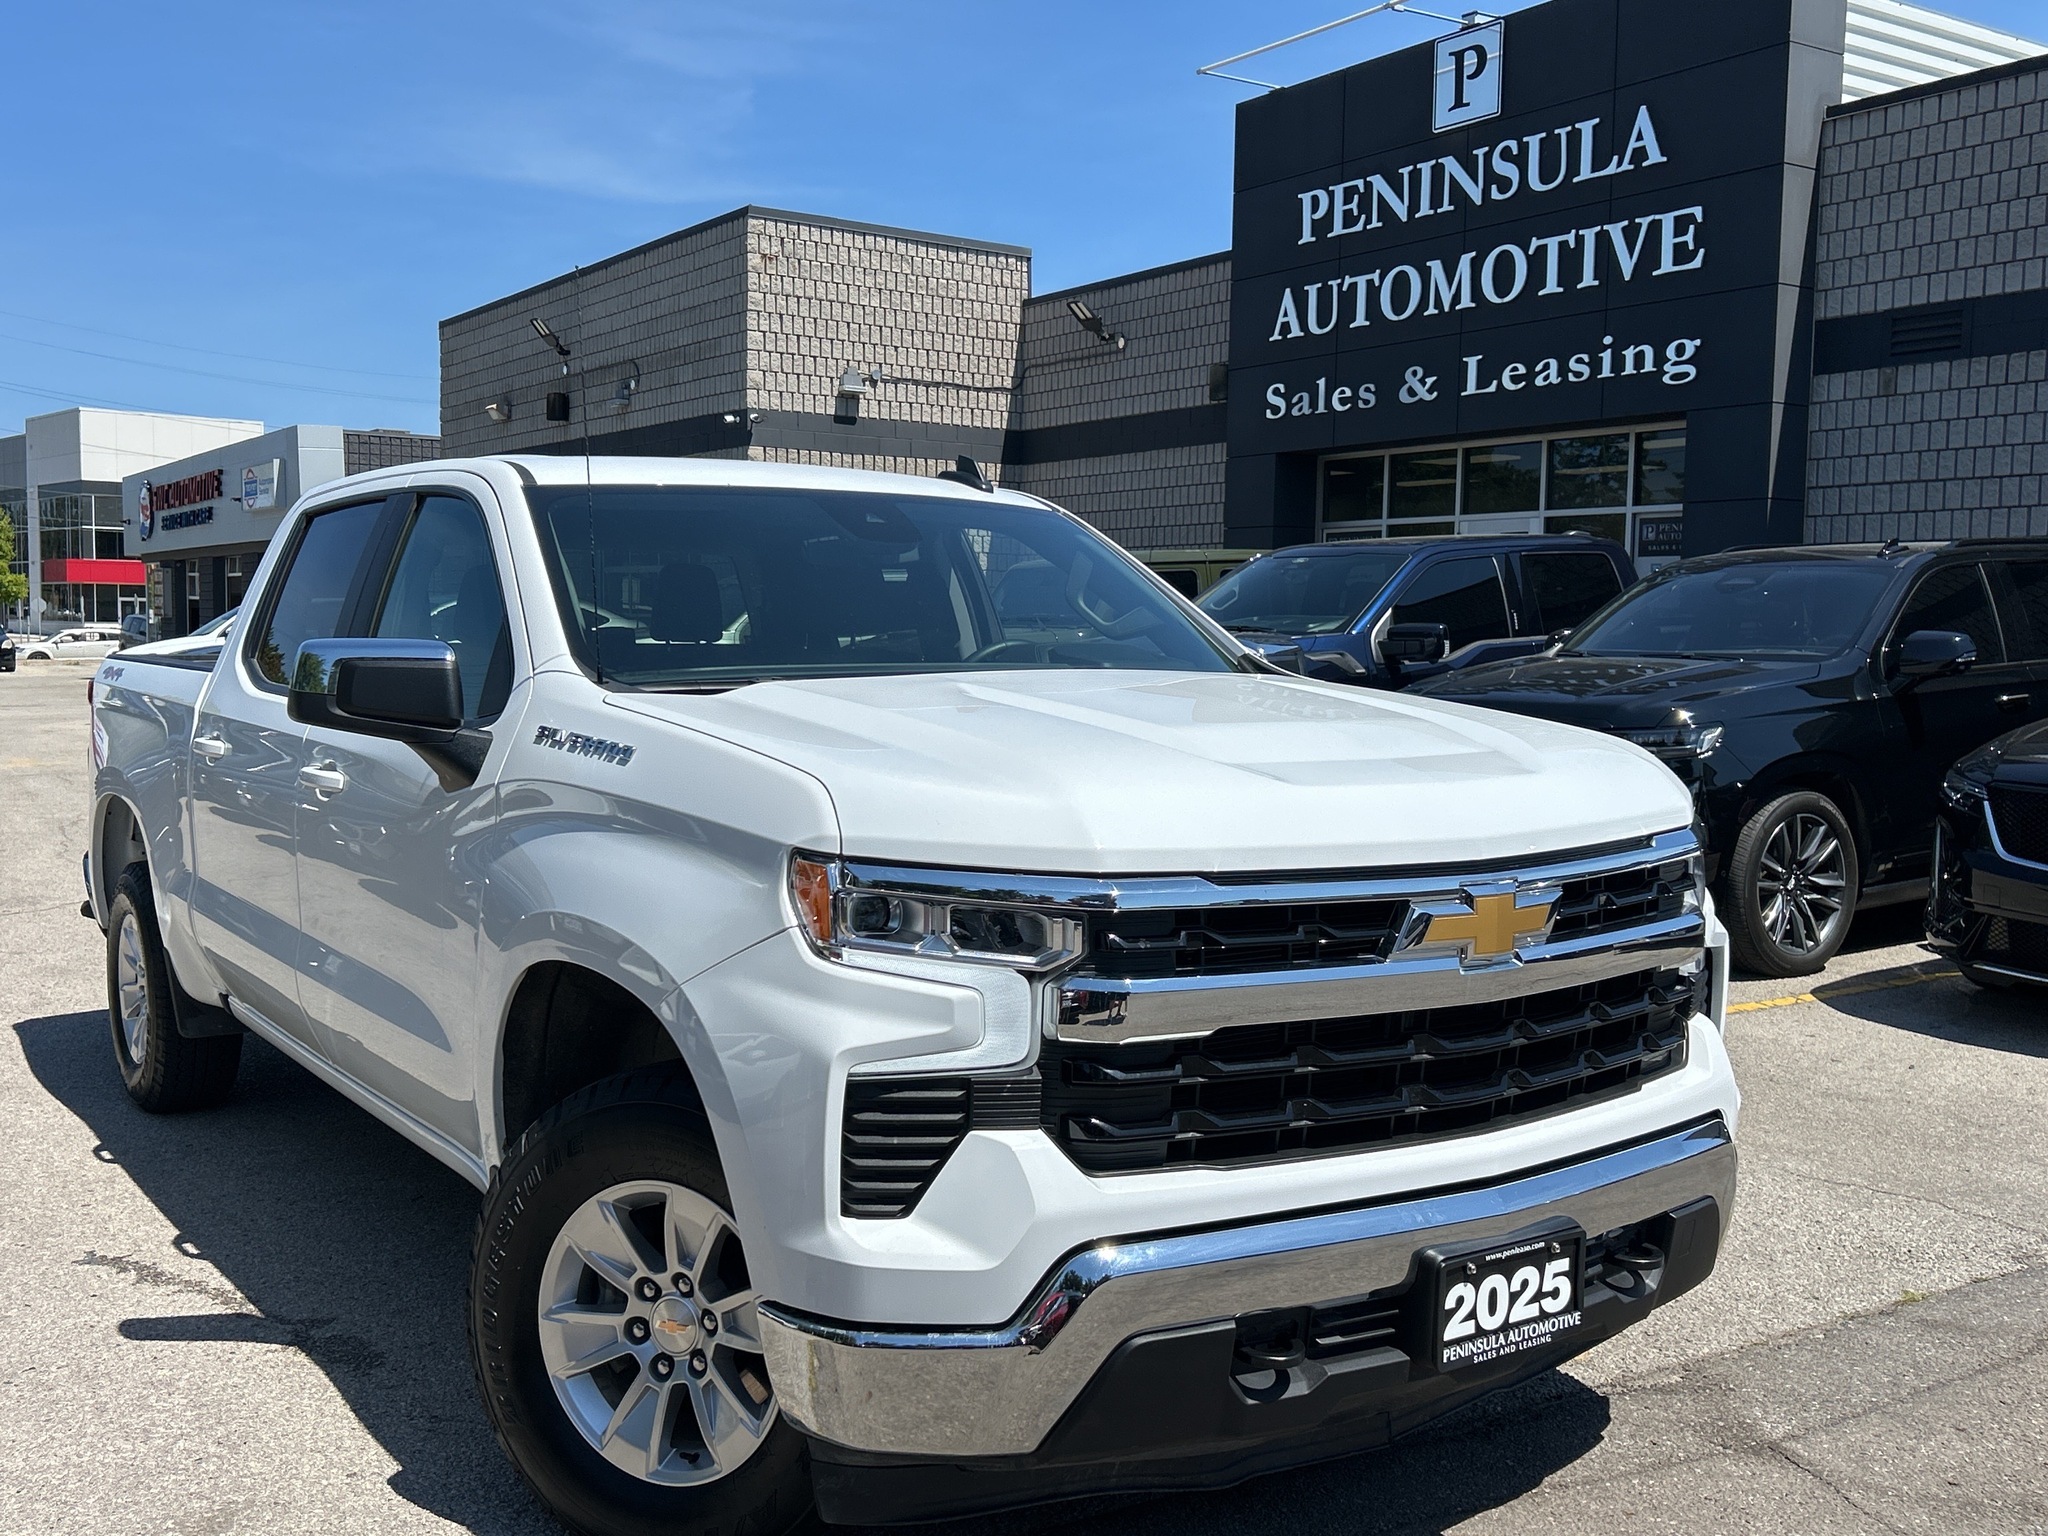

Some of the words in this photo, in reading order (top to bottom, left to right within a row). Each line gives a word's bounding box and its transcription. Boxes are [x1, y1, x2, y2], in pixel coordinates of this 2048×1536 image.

[1447, 44, 1488, 113] P
[1298, 105, 1667, 246] PENINSULA
[1268, 206, 1705, 342] AUTOMOTIVE
[1265, 378, 1377, 420] Sales
[1399, 366, 1438, 404] &
[1460, 336, 1701, 396] Leasing
[169, 469, 223, 508] AUTOMOTIVE
[1443, 1257, 1572, 1341] 2025
[1443, 1333, 1506, 1363] PENINSULA
[1507, 1311, 1582, 1345] AUTOMOTIVE
[1473, 1349, 1497, 1364] SALES
[1499, 1344, 1516, 1356] AND
[1518, 1334, 1552, 1351] LEASING
